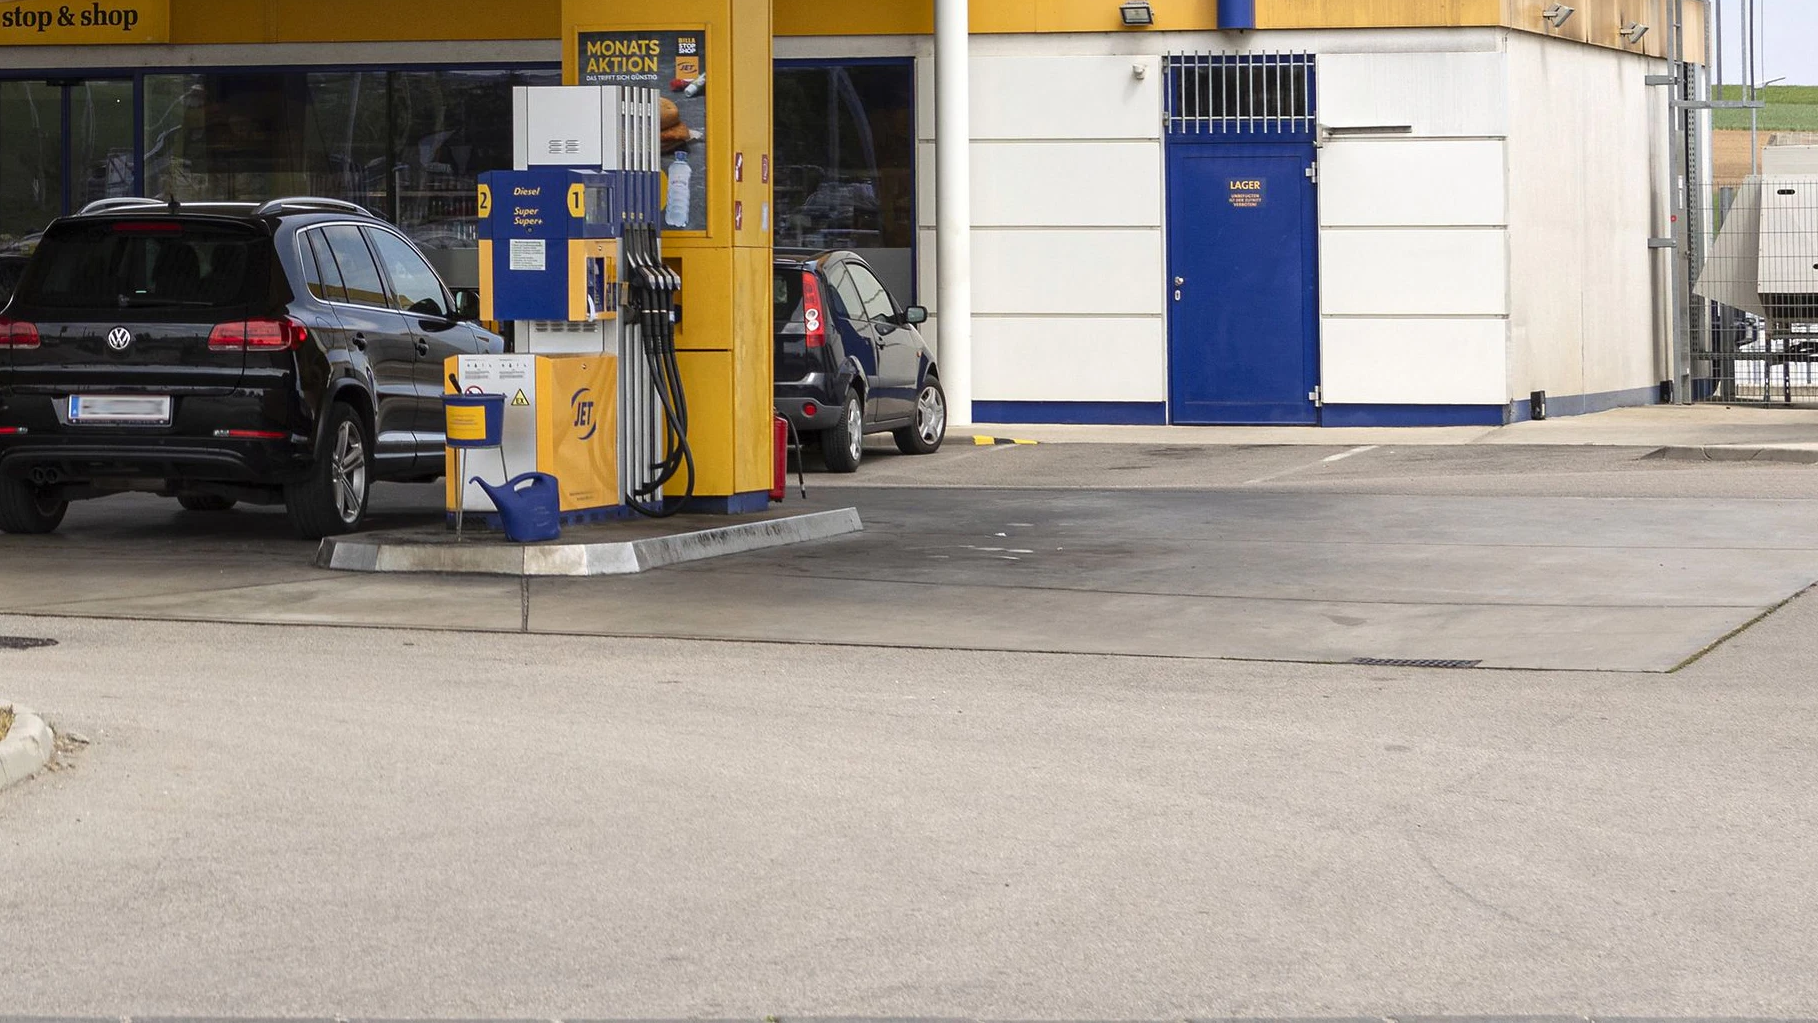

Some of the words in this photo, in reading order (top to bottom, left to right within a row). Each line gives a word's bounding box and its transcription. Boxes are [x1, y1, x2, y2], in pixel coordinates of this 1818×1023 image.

[2, 5, 52, 32] stop
[57, 5, 75, 26] &
[80, 2, 138, 30] shop
[587, 40, 660, 56] MONATS
[586, 56, 659, 73] AKTION
[631, 73, 658, 81] GÜNSTIG
[513, 187, 540, 196] Diesel
[1230, 180, 1261, 190] LAGER
[479, 191, 488, 209] 2
[572, 191, 579, 209] 1
[513, 207, 539, 217] Super
[513, 217, 544, 227] Super+
[573, 401, 594, 427] JET
